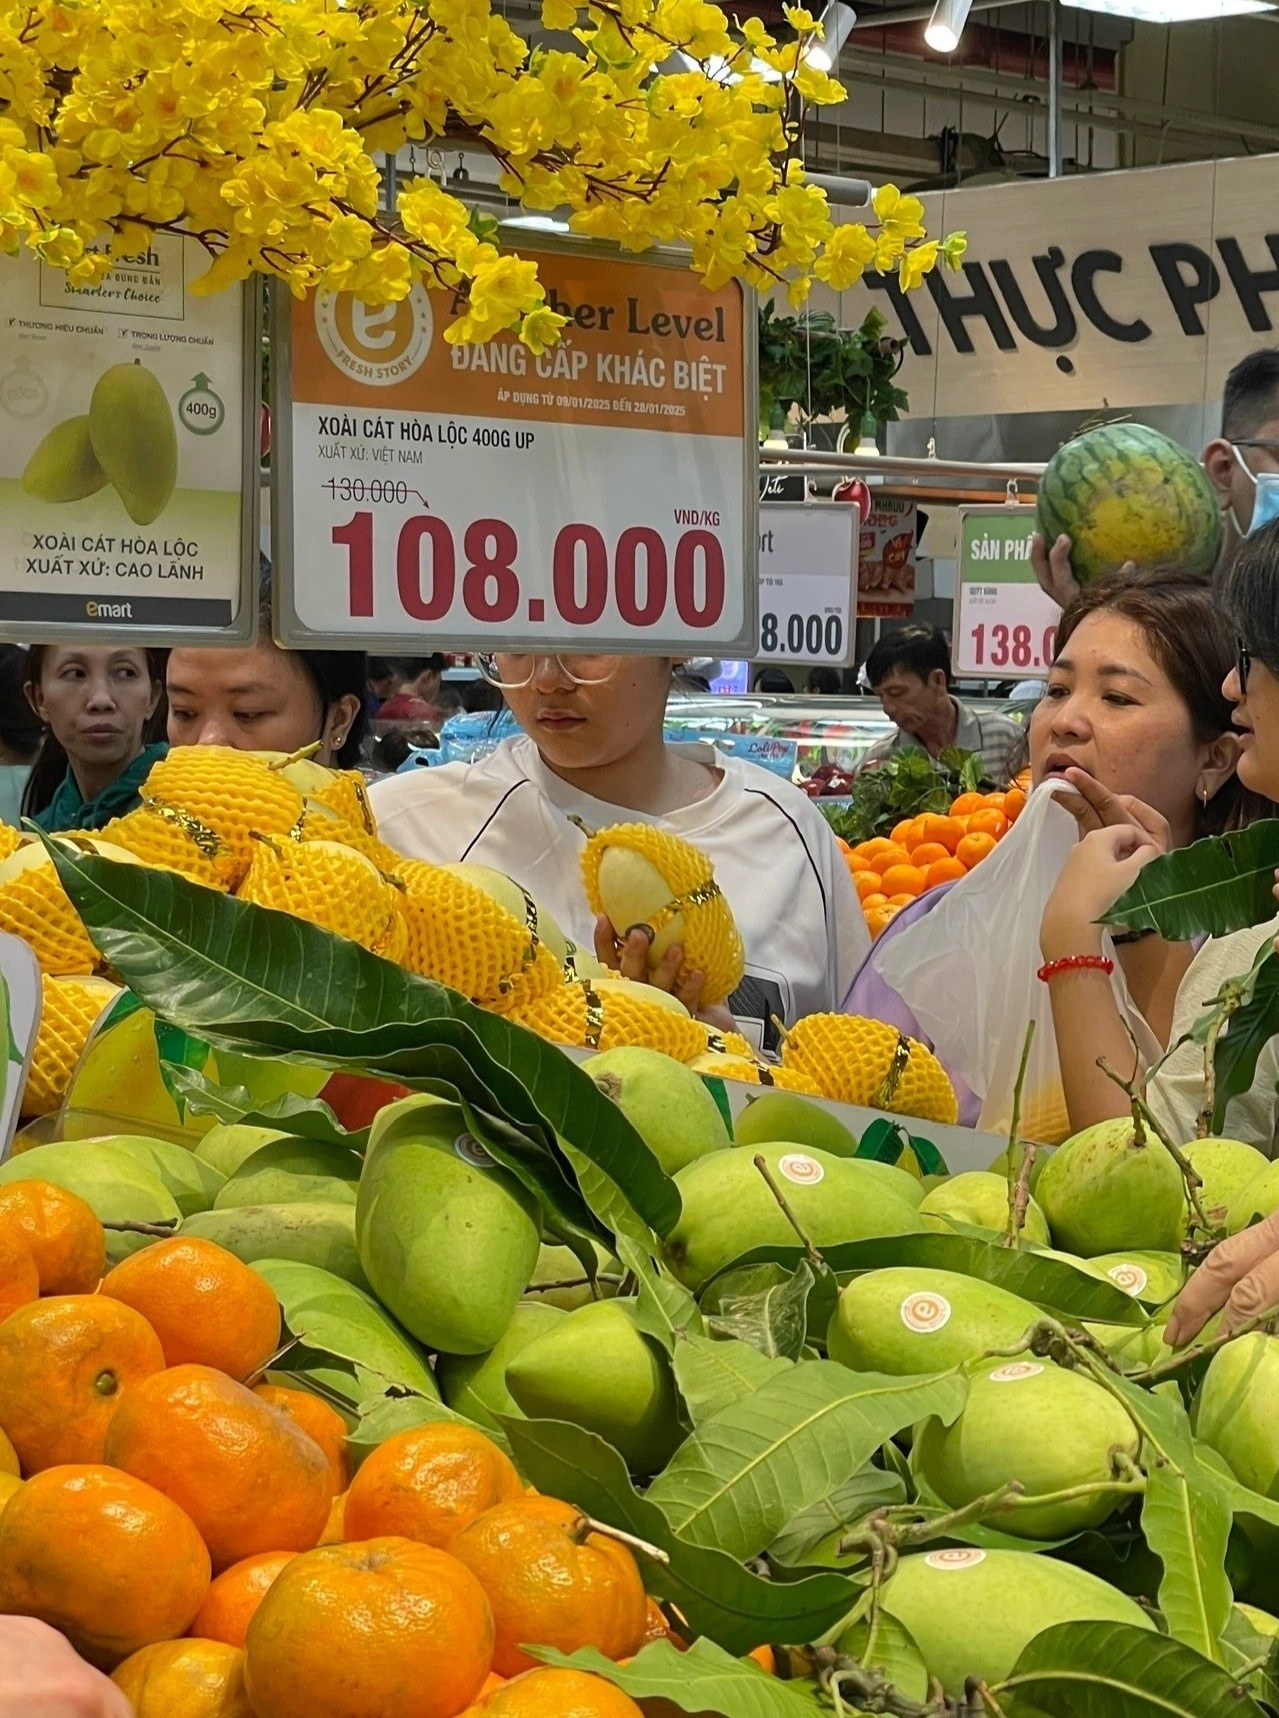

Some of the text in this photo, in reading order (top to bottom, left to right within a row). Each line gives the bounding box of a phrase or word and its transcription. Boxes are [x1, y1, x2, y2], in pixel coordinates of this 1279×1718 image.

[627, 297, 725, 343] Level
[862, 246, 1153, 376] THỰC
[337, 350, 412, 379] FRESH STORY
[536, 339, 588, 380] CẤP
[597, 349, 665, 388] KHÁC
[674, 356, 727, 401] BIỆT
[186, 402, 217, 419] 400g
[497, 388, 686, 417] ÁP DỤNG TỪ 09/01/2025 ĐẾN 28/01/2025
[318, 413, 535, 449] XOÀI CÁT HÒA LỘC 400G UP
[318, 442, 423, 466] XUẤT XỨ: VIỆT NAM
[328, 476, 407, 504] 130.000
[673, 508, 720, 527] VND/KG
[33, 532, 198, 560] XOÀI CÁT HÒA LỘC
[971, 532, 1001, 560] SẢN
[26, 553, 204, 580] XUẤT XỨ: CAO LÃNH
[332, 511, 725, 628] 108.000
[87, 601, 133, 618] emart
[761, 613, 843, 656] 8.000
